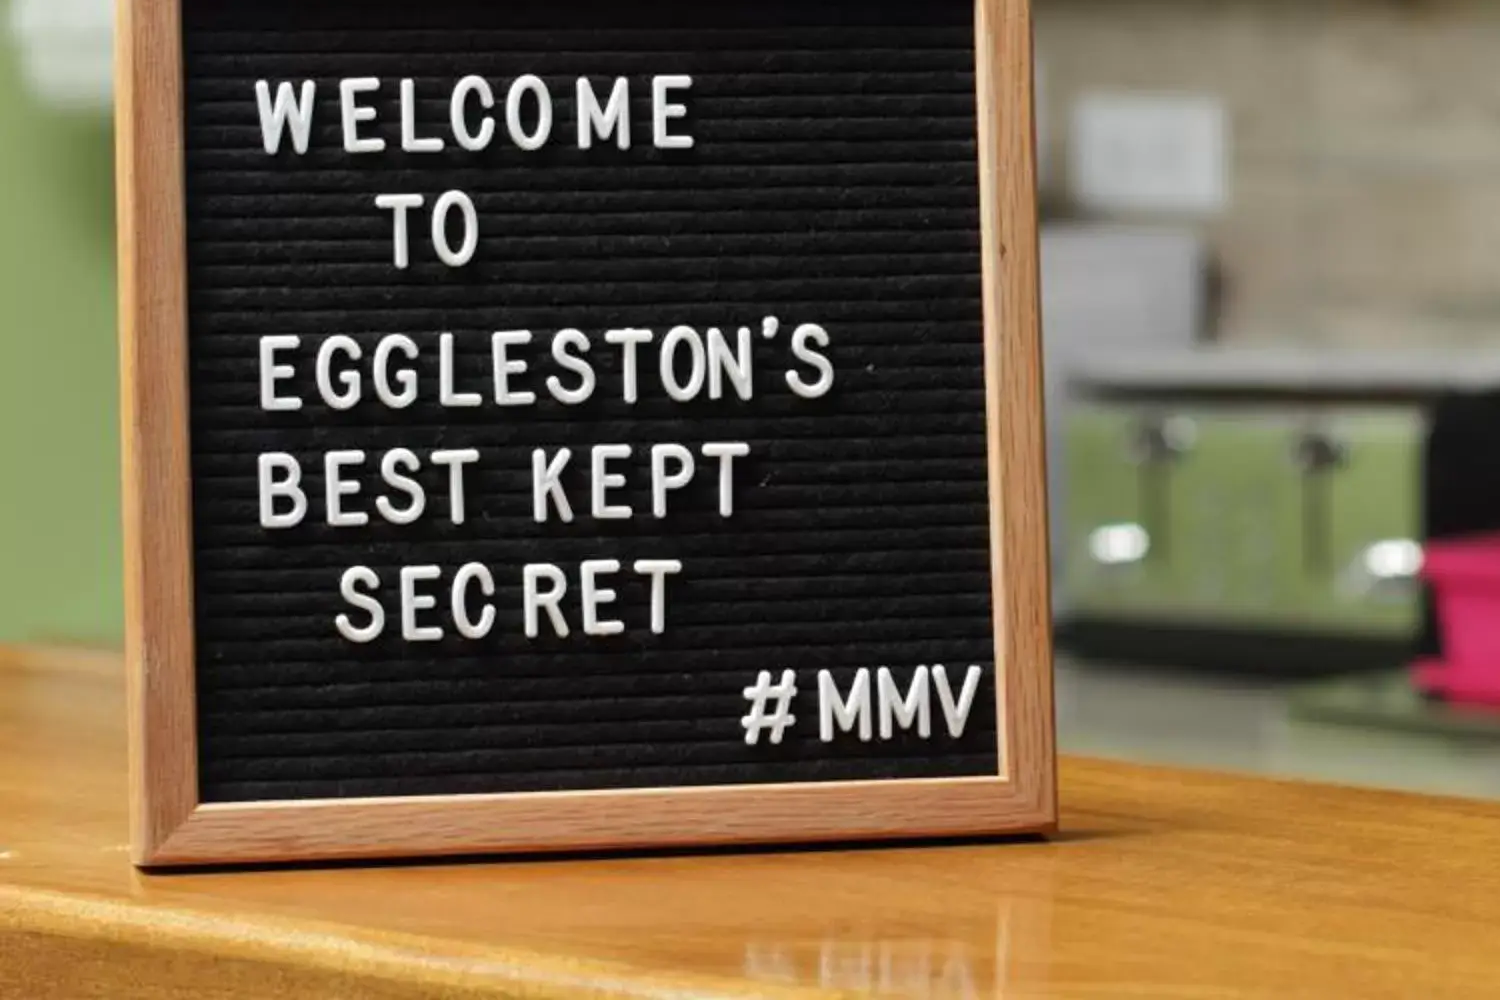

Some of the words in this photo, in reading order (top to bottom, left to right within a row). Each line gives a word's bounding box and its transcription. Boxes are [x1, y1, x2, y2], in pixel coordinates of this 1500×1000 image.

[254, 73, 694, 156] WELCOME
[374, 189, 478, 269] TO
[257, 315, 834, 412] EGGLESTON'S
[257, 447, 480, 528] BEST
[531, 442, 750, 522] KEPT
[334, 559, 682, 643] SECRET
